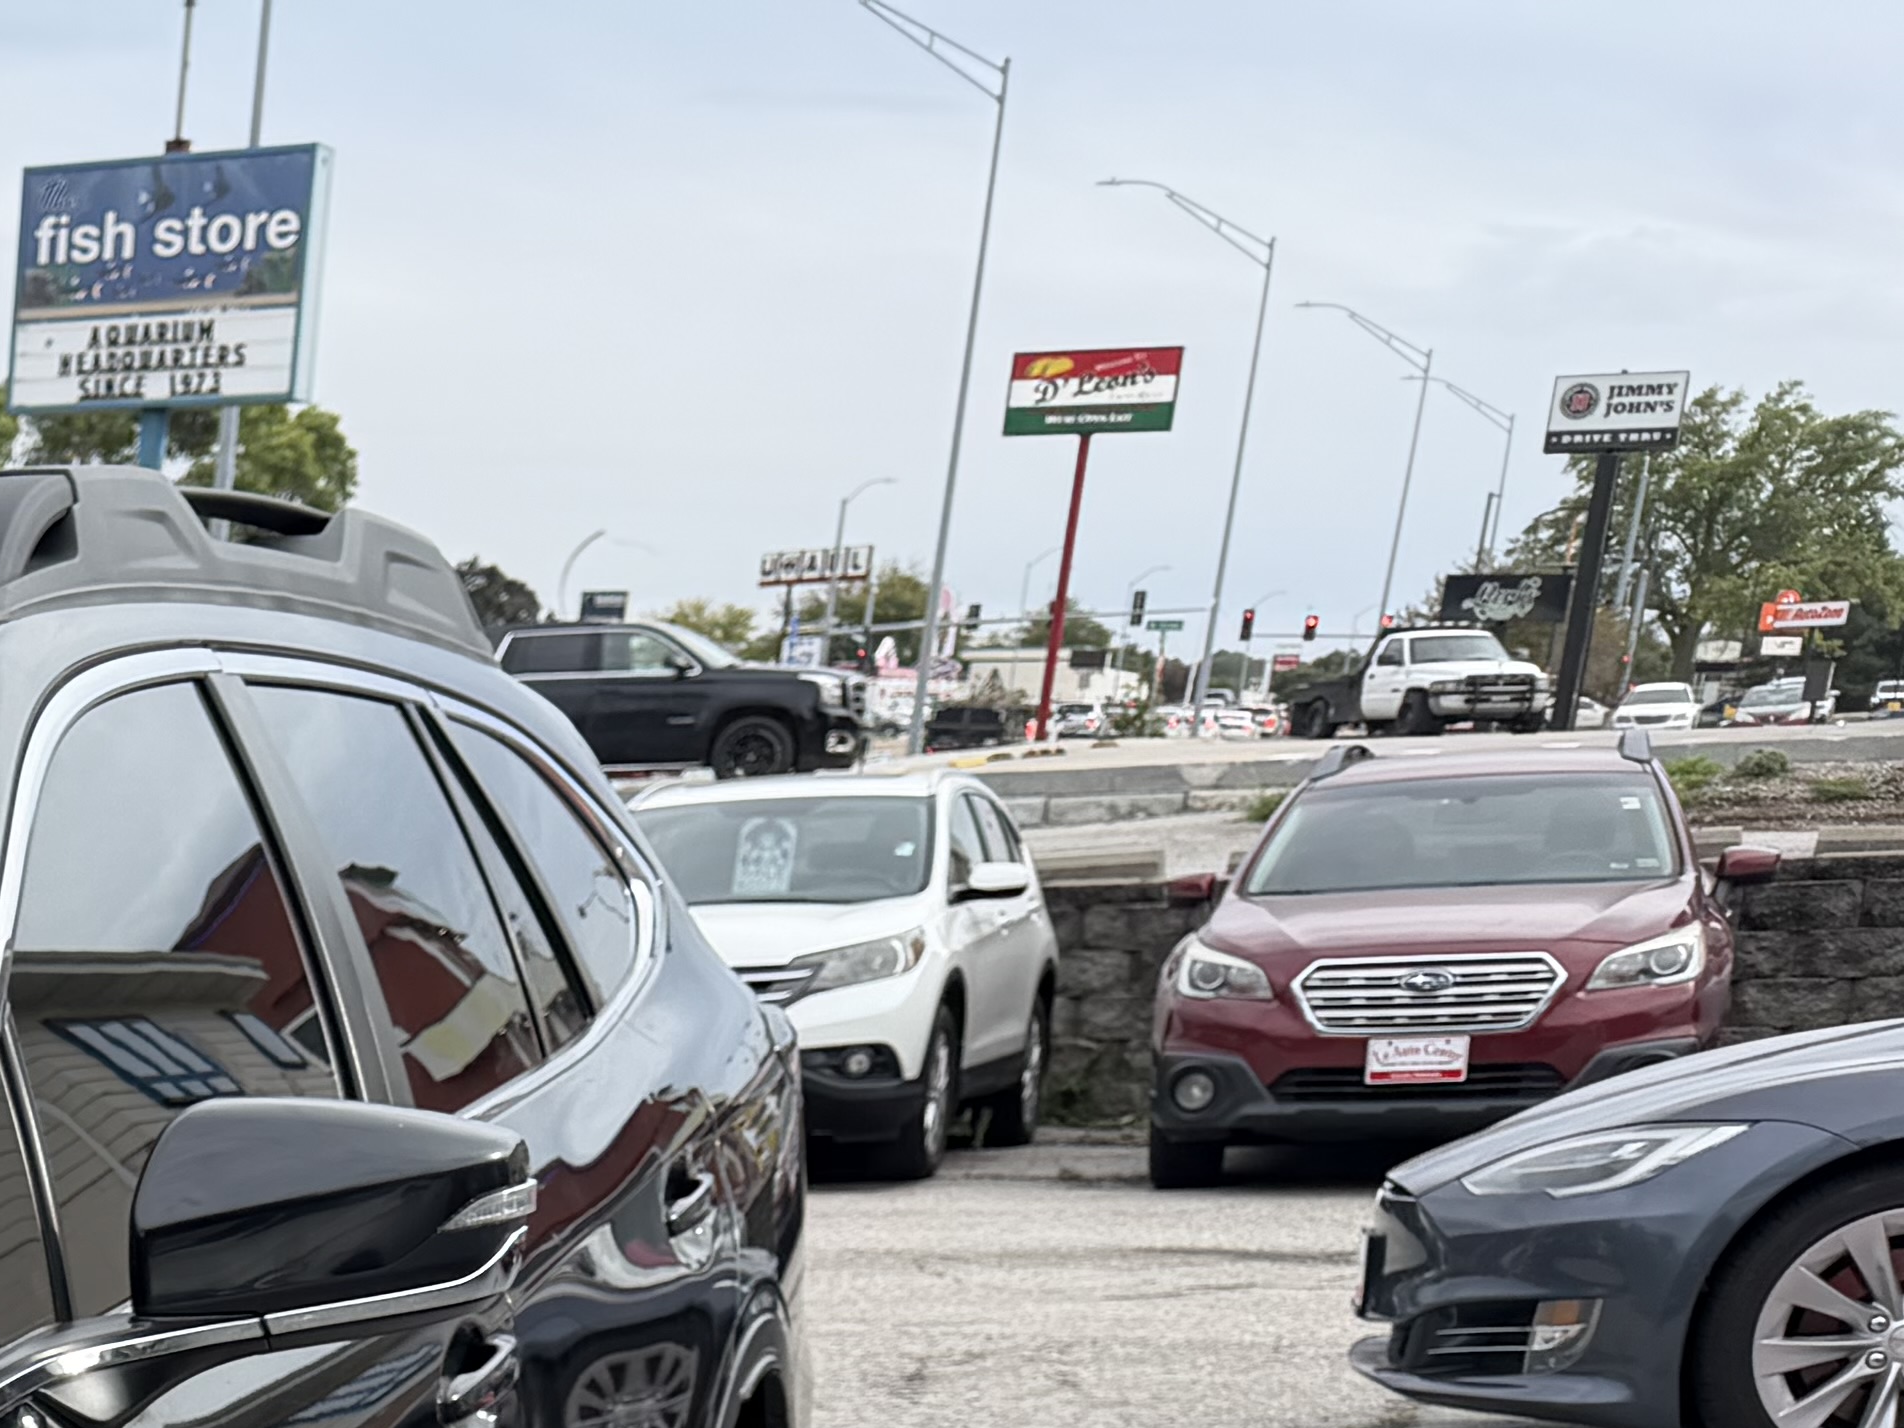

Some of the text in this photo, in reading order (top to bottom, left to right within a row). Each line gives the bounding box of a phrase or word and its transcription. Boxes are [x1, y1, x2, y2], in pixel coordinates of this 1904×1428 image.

[34, 206, 301, 266] fish store
[88, 319, 215, 349] AQUARIUM
[58, 343, 247, 377] HEADQUARTERS
[78, 370, 222, 400] SINCE 1973
[1608, 383, 1678, 400] JIMMY
[1604, 401, 1674, 418] JOHN'S
[1560, 431, 1662, 444] DRIVE THRU
[1792, 605, 1844, 620] AutoZone
